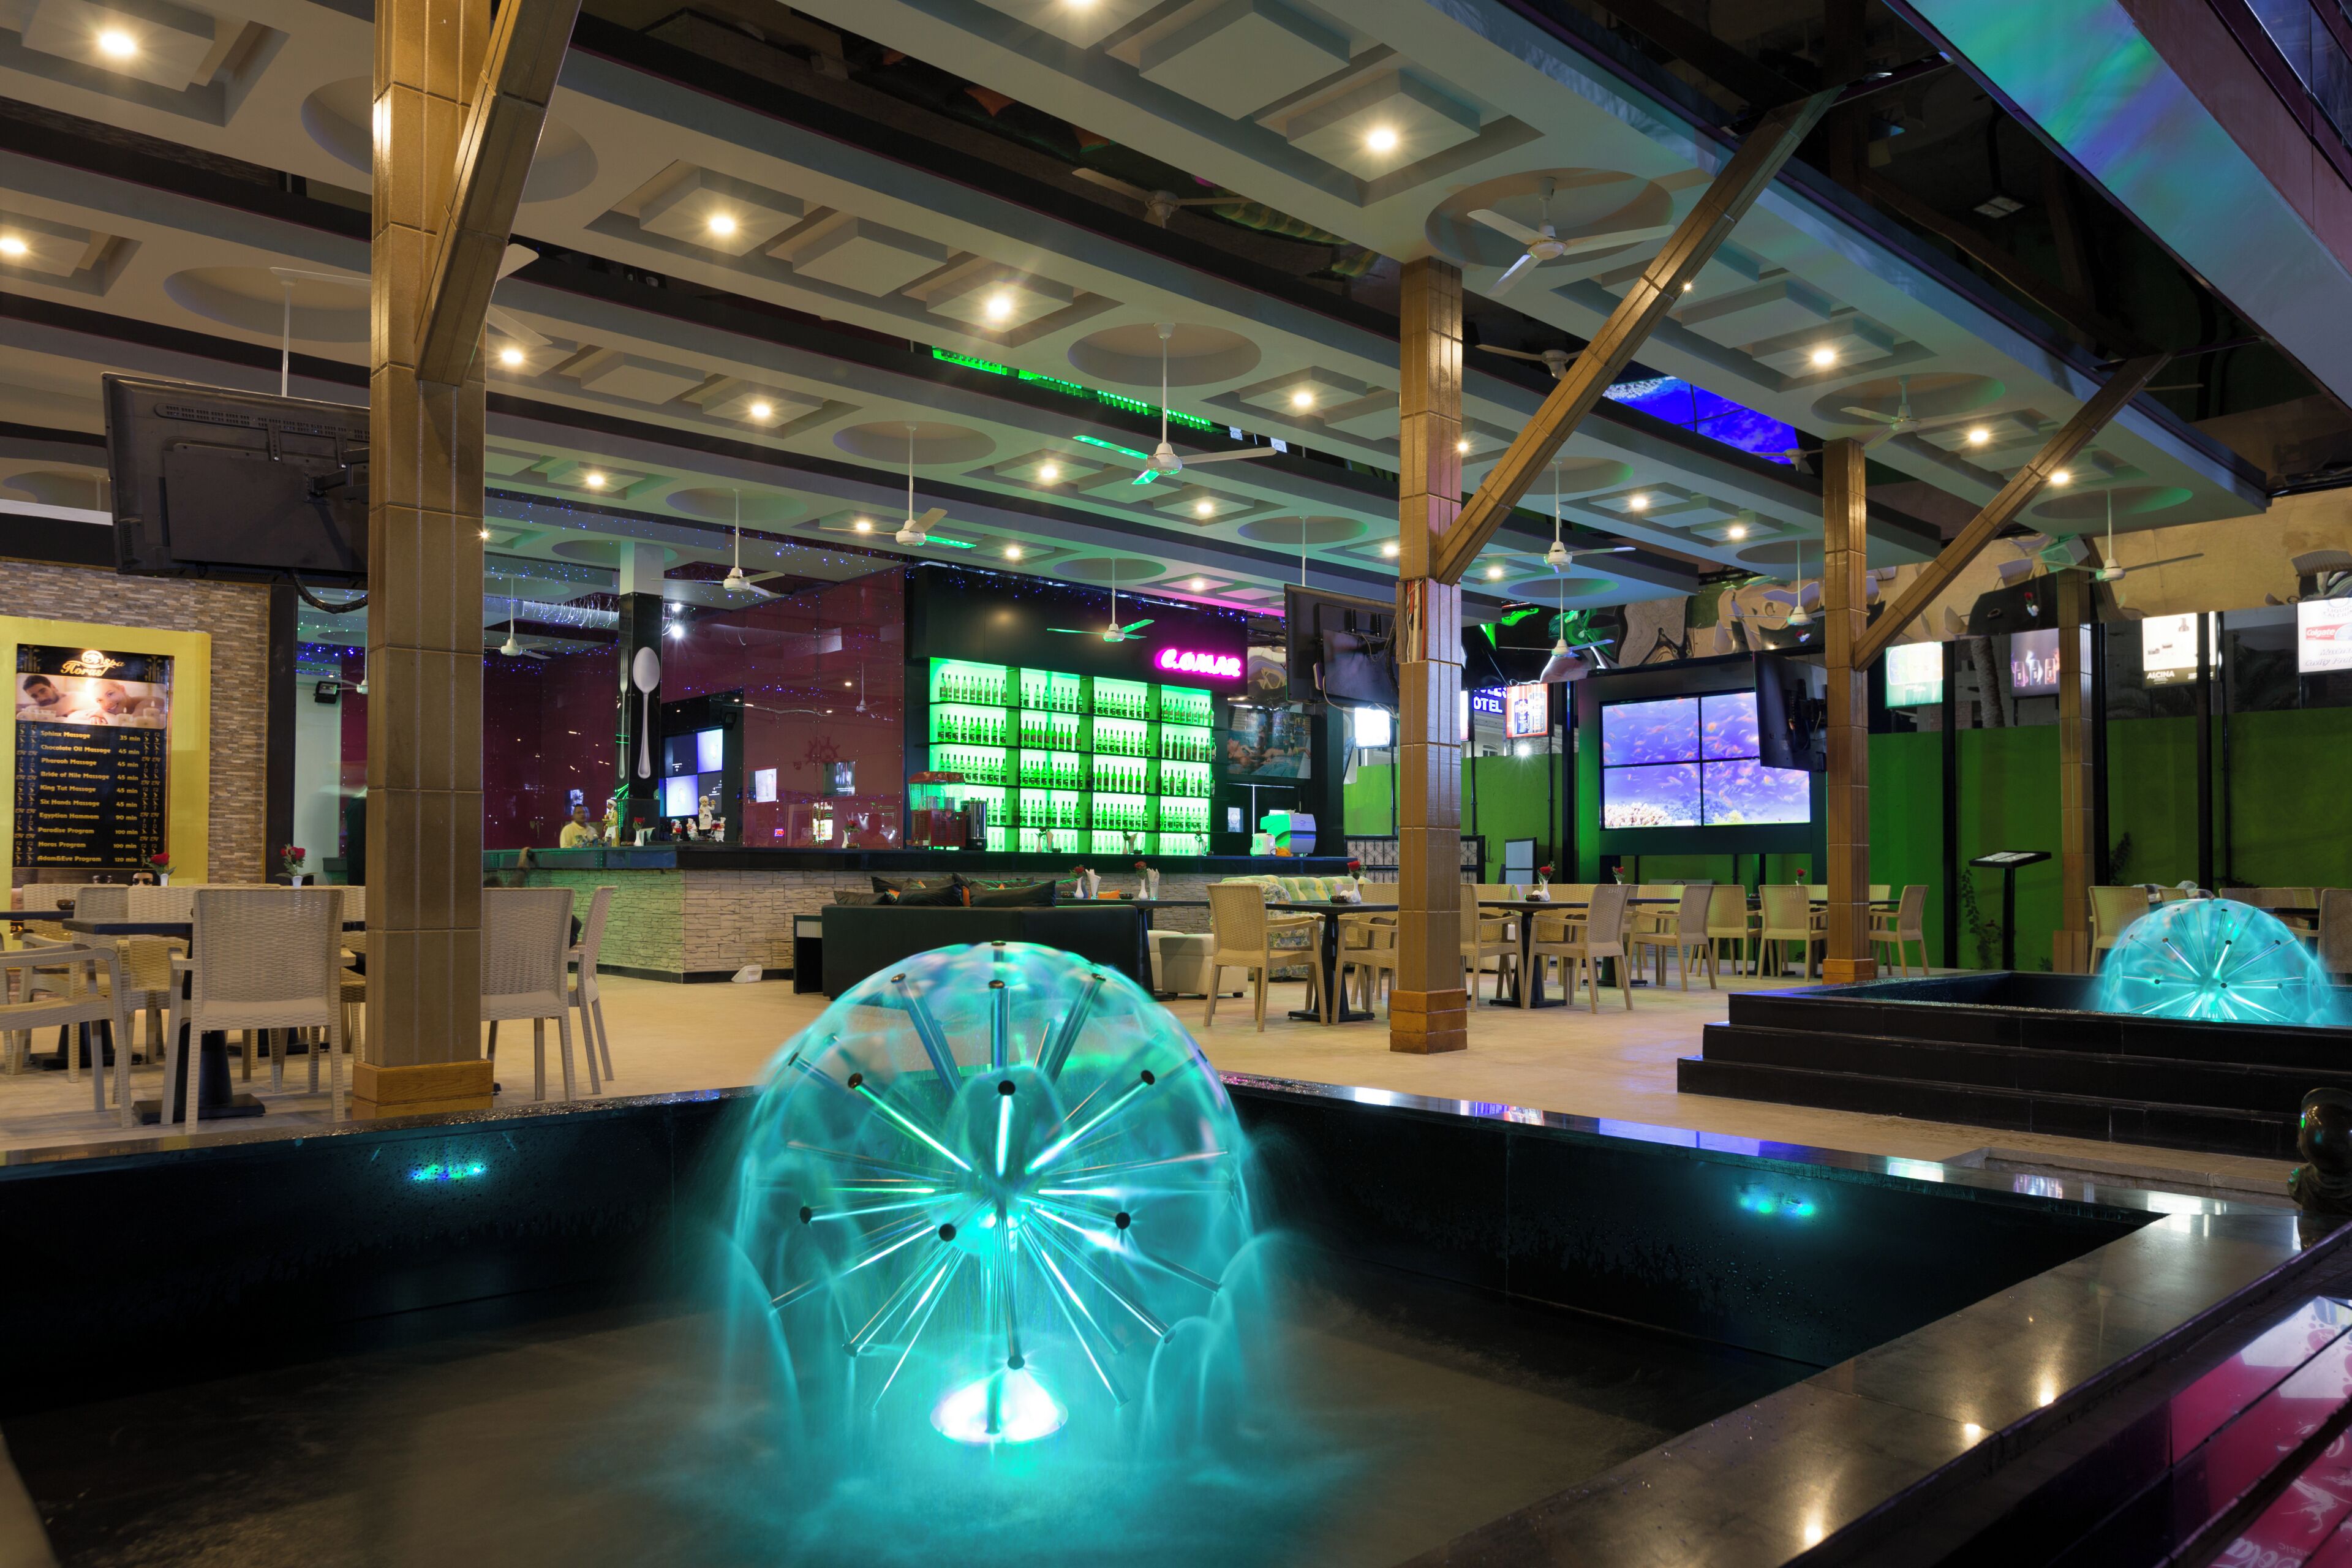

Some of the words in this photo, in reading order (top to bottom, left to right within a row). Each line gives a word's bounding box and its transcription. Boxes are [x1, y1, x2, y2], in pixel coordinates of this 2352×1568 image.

[2307, 628, 2335, 637] Colgate
[2147, 671, 2175, 679] ALCINA
[1473, 696, 1503, 714] OTEL
